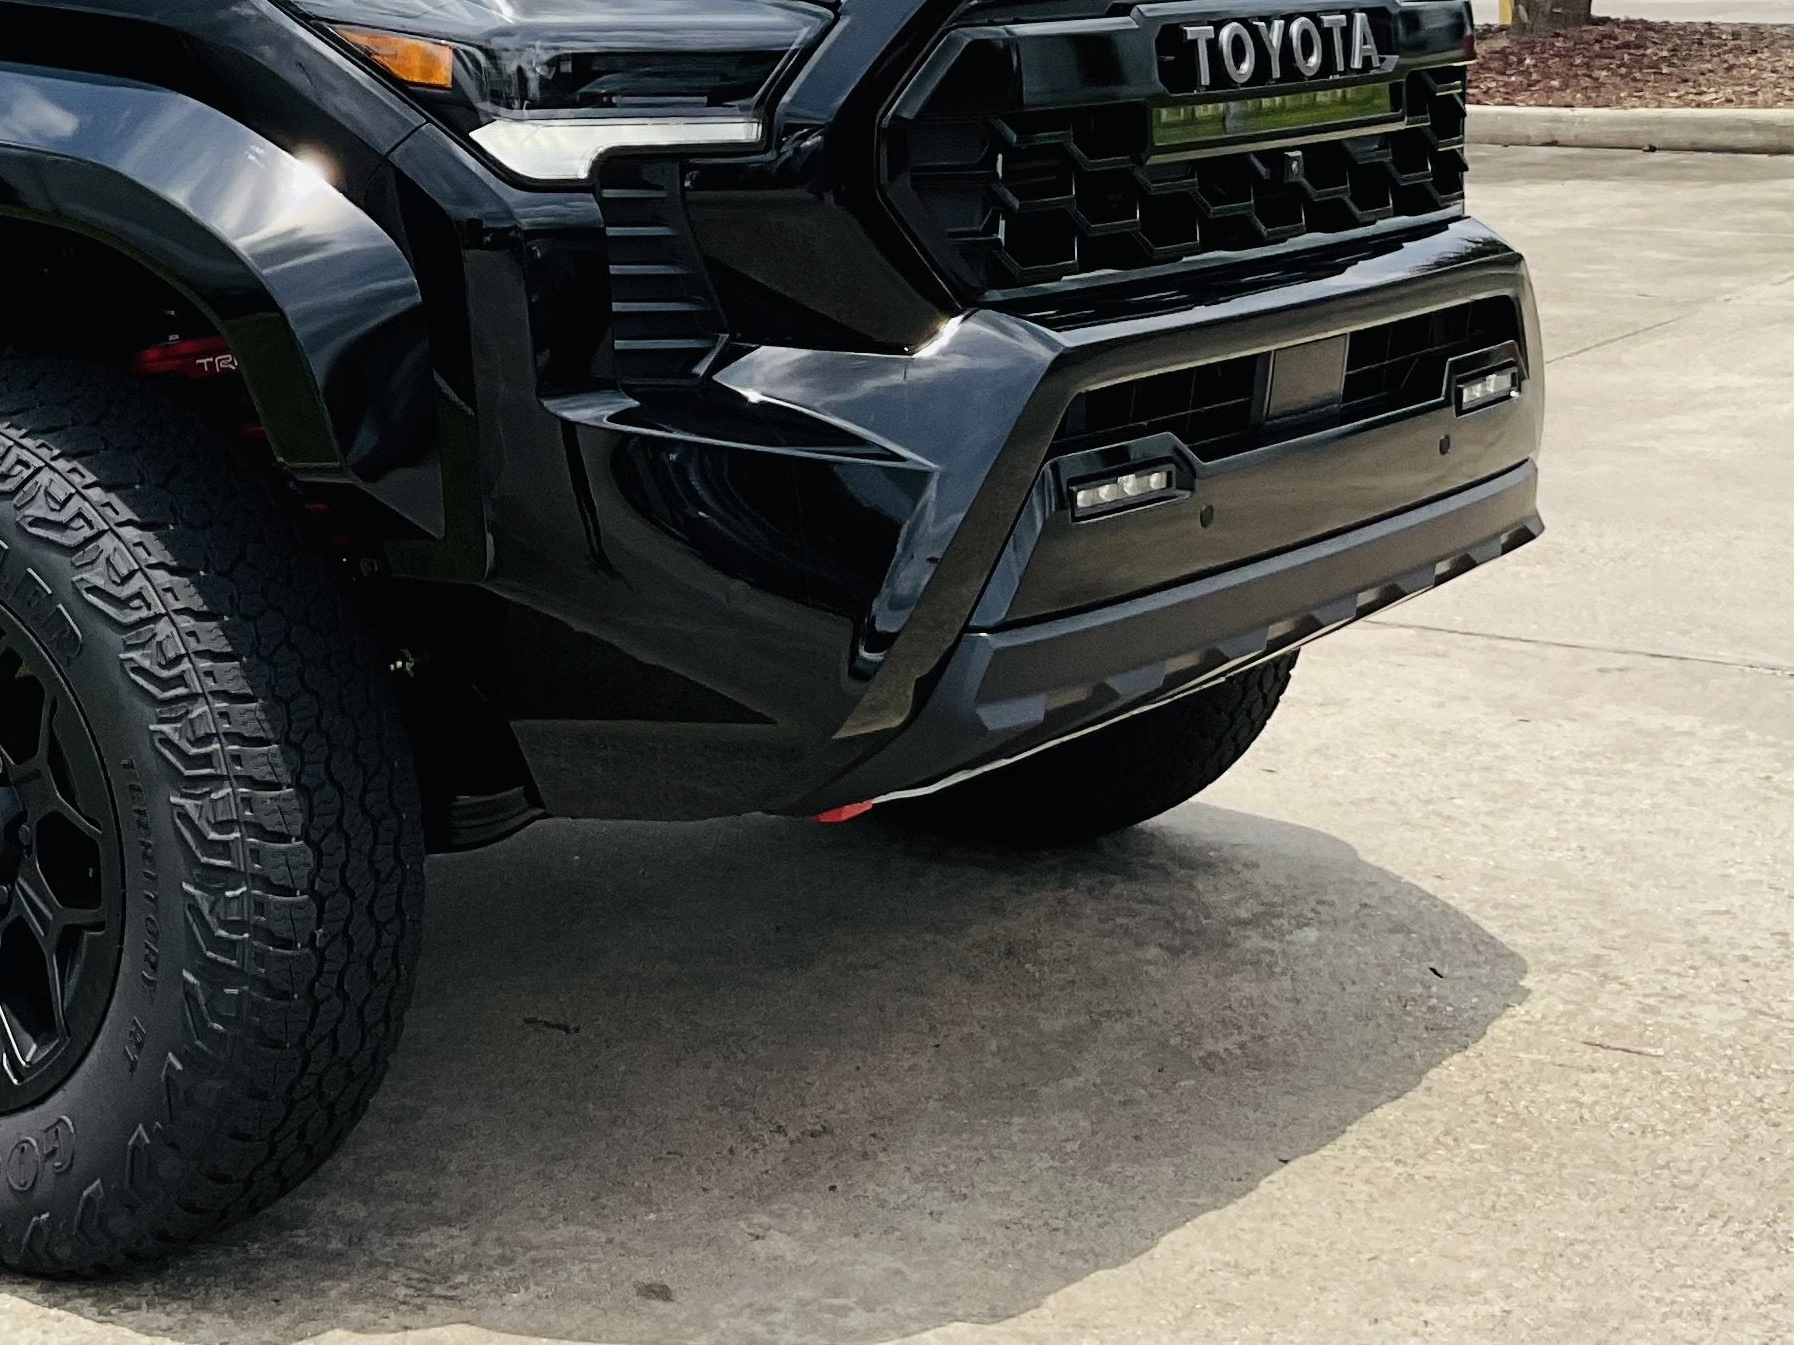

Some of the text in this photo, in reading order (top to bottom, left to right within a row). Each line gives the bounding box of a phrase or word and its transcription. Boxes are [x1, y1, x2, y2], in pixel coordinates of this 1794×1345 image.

[1183, 12, 1380, 85] TOYOTA
[196, 353, 239, 373] TR
[119, 756, 160, 1006] TERRITORY
